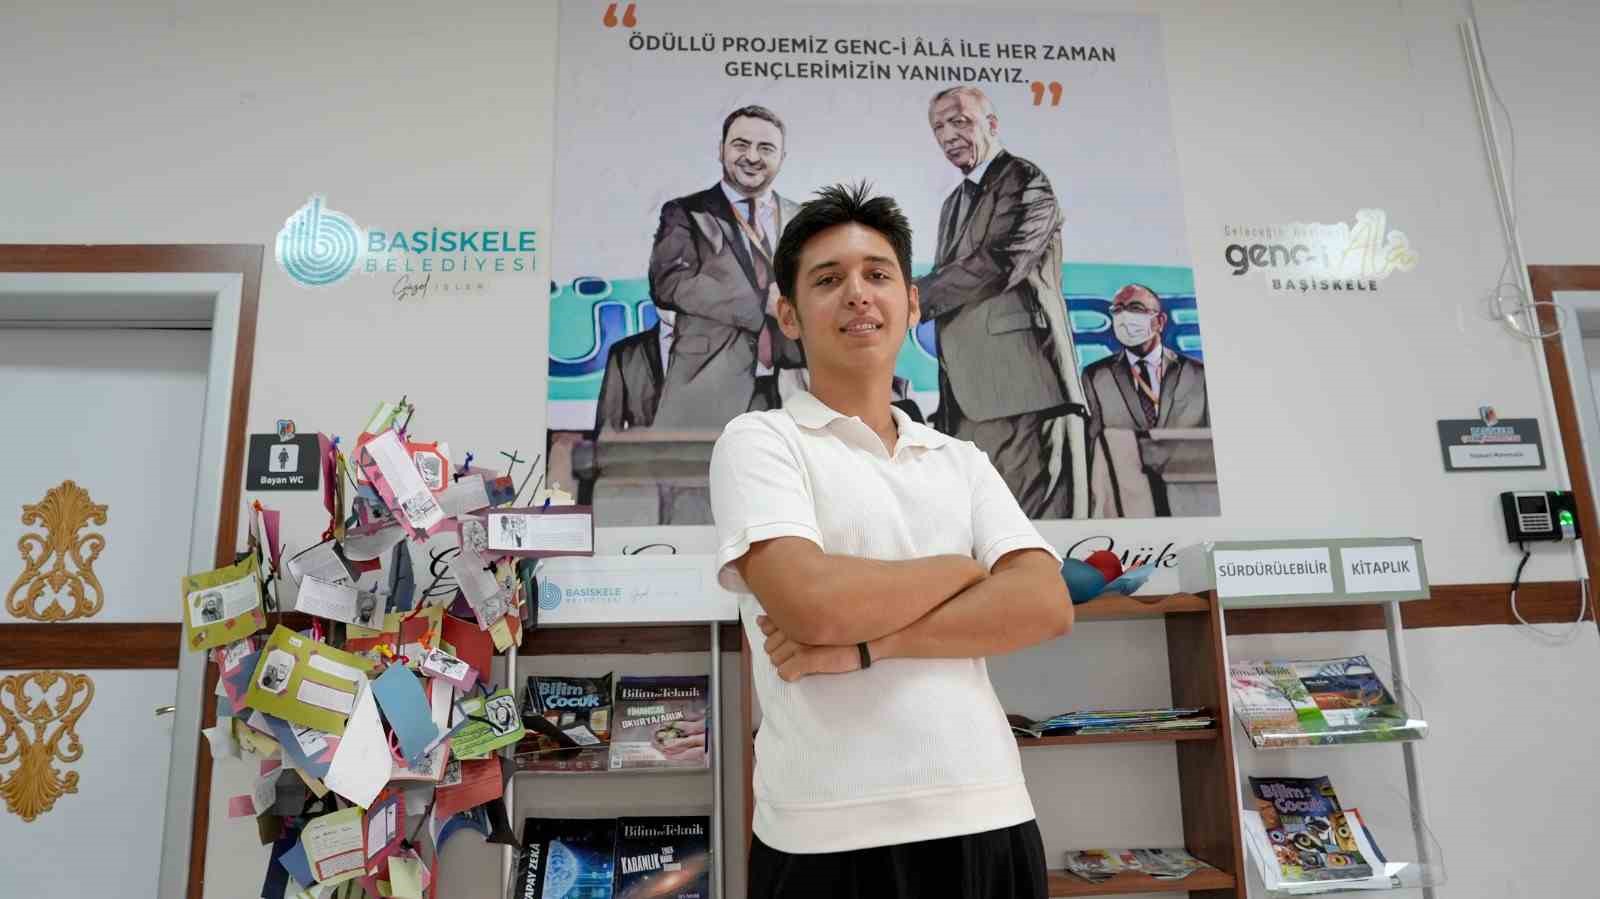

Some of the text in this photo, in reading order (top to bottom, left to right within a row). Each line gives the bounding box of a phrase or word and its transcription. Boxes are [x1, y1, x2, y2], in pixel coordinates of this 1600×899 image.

[629, 32, 1117, 62] ÖDÜLLÜ PROJEMİZ GENC-İ ÂLÂ İLE HER ZAMAN
[725, 60, 1030, 84] GENÇLERİMİZİN YANINDAYIZ.
[367, 227, 537, 255] BAŞİSKELE
[365, 255, 536, 273] BELEDİYESİ
[1271, 277, 1378, 292] BAŞİSKELE
[260, 475, 304, 485] Bayan WC
[1218, 558, 1411, 577] SÜRDÜRÜLEBİLİR KİTAPLIK
[539, 682, 583, 696] Bilim
[546, 694, 600, 708] Çocuk
[1260, 783, 1304, 799] Bilim
[624, 825, 656, 837] Bilim
[664, 824, 704, 836] Teknik
[621, 853, 661, 874] KARANLIK
[524, 871, 537, 899] APAY
